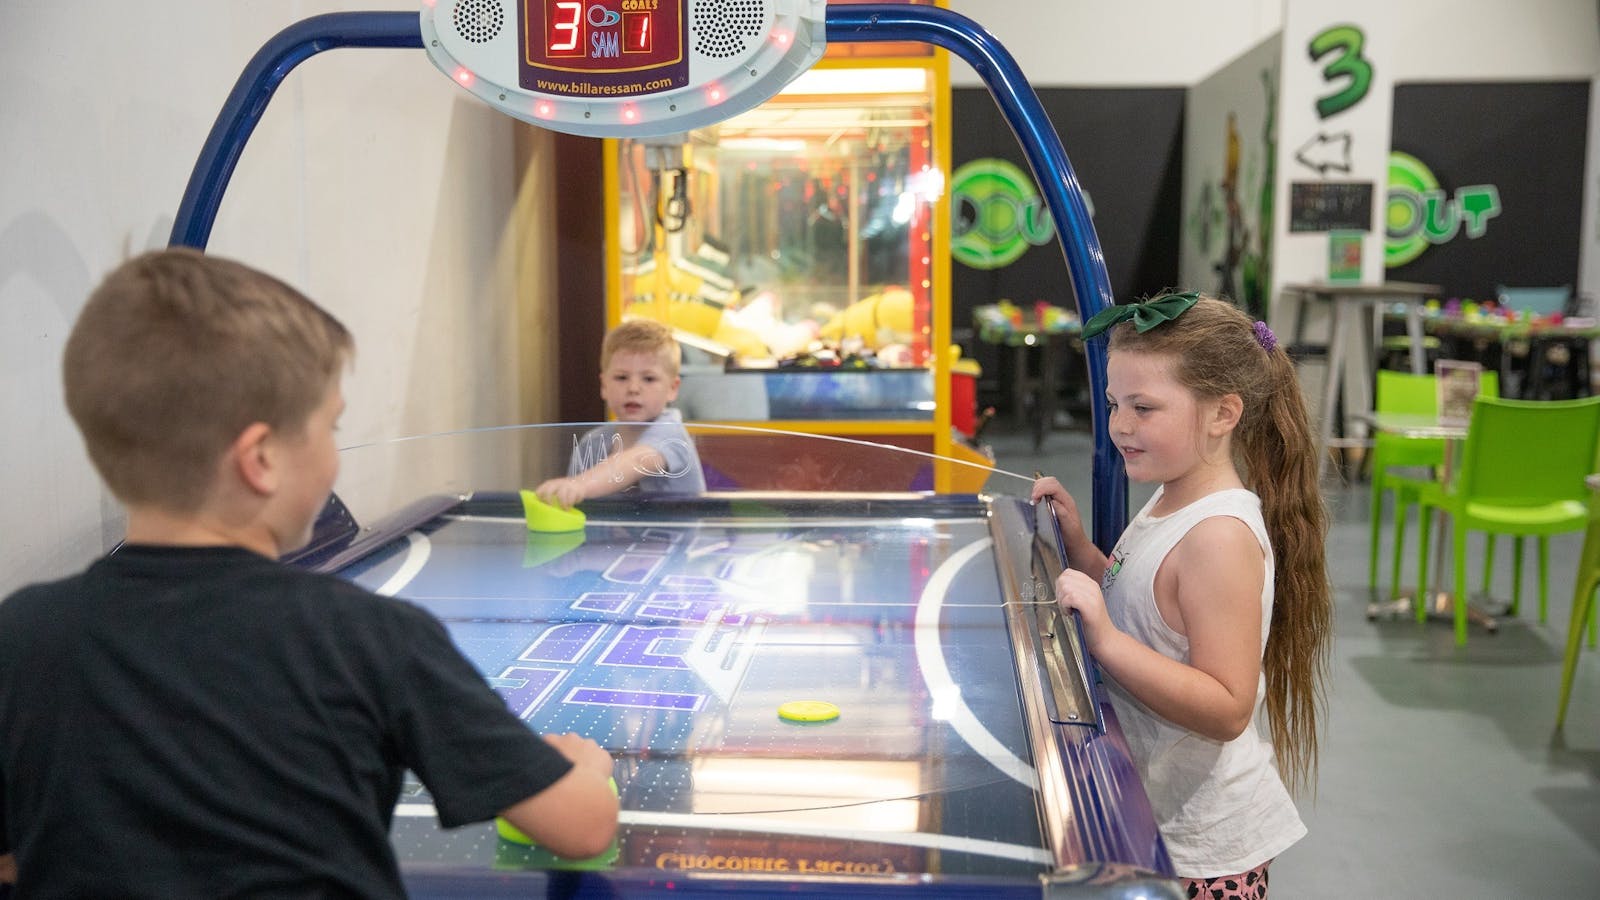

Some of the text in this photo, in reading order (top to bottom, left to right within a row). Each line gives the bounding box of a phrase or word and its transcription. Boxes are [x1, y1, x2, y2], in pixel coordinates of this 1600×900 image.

[621, 0, 658, 10] GOALS
[551, 2, 582, 50] 3
[640, 17, 649, 48] 1
[592, 31, 620, 58] SAM
[1308, 23, 1375, 120] 3
[536, 78, 673, 95] www.billaressam.com
